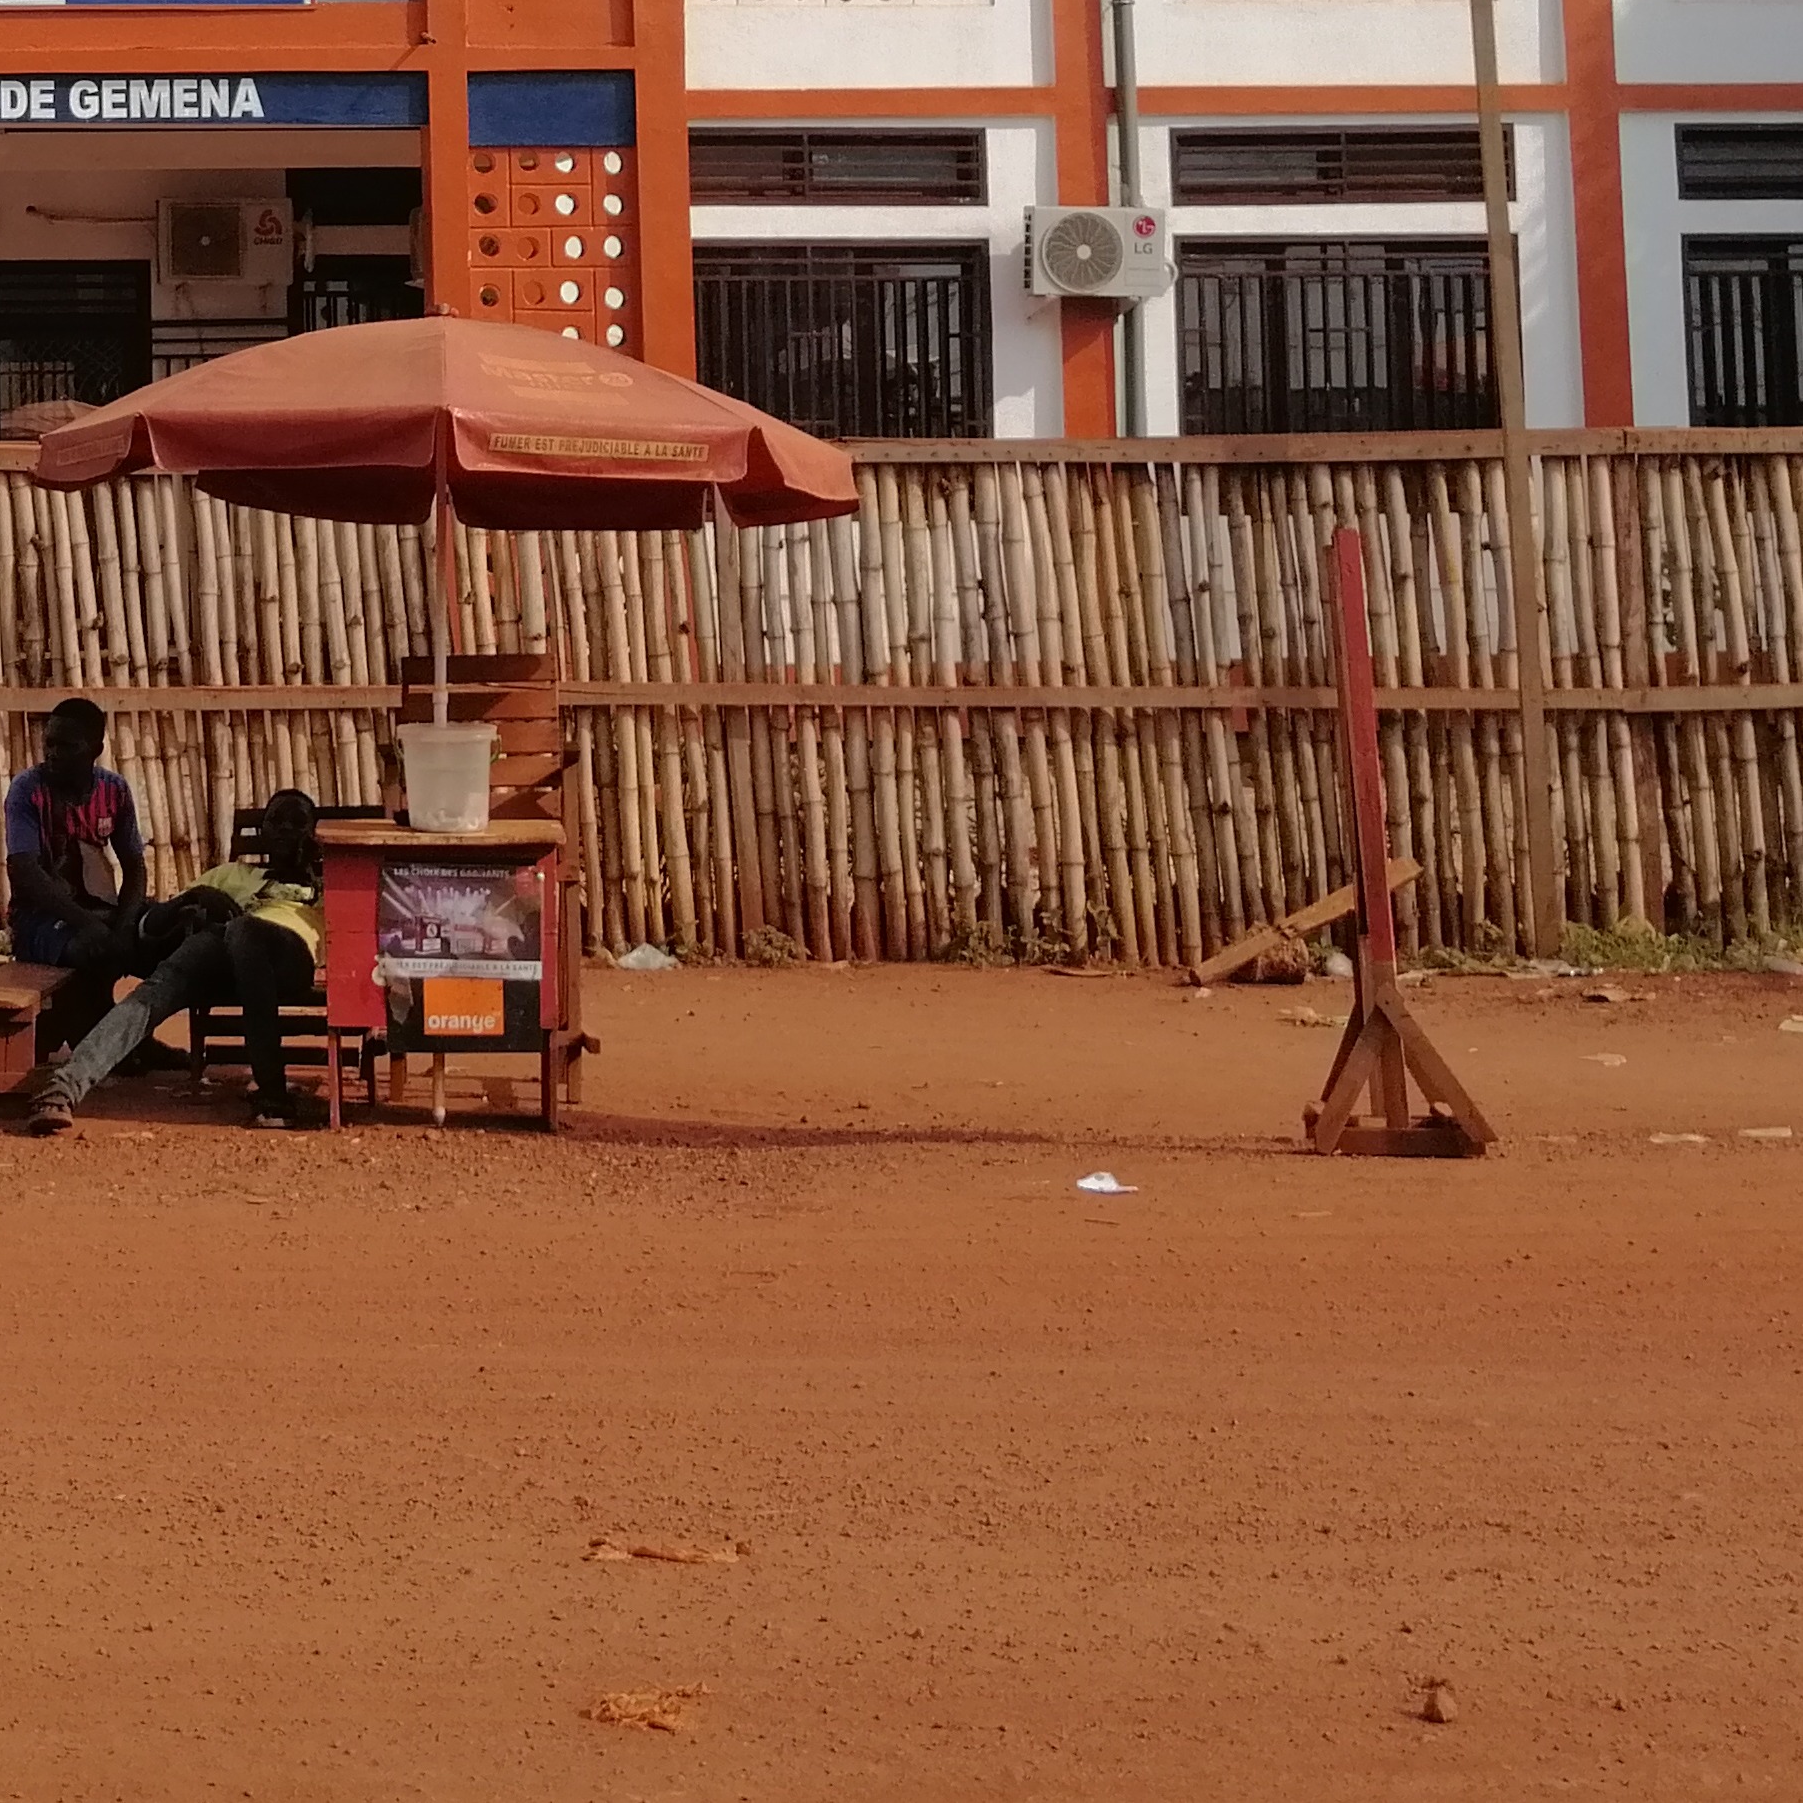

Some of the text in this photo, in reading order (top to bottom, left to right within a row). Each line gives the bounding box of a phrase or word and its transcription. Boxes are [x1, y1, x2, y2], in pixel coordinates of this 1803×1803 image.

[0, 80, 57, 120] DE
[69, 78, 265, 119] GEMENA
[1134, 242, 1153, 255] LG
[494, 436, 530, 450] FUMER
[535, 438, 555, 451] EST
[655, 445, 669, 457] LA
[428, 1013, 496, 1034] orange
